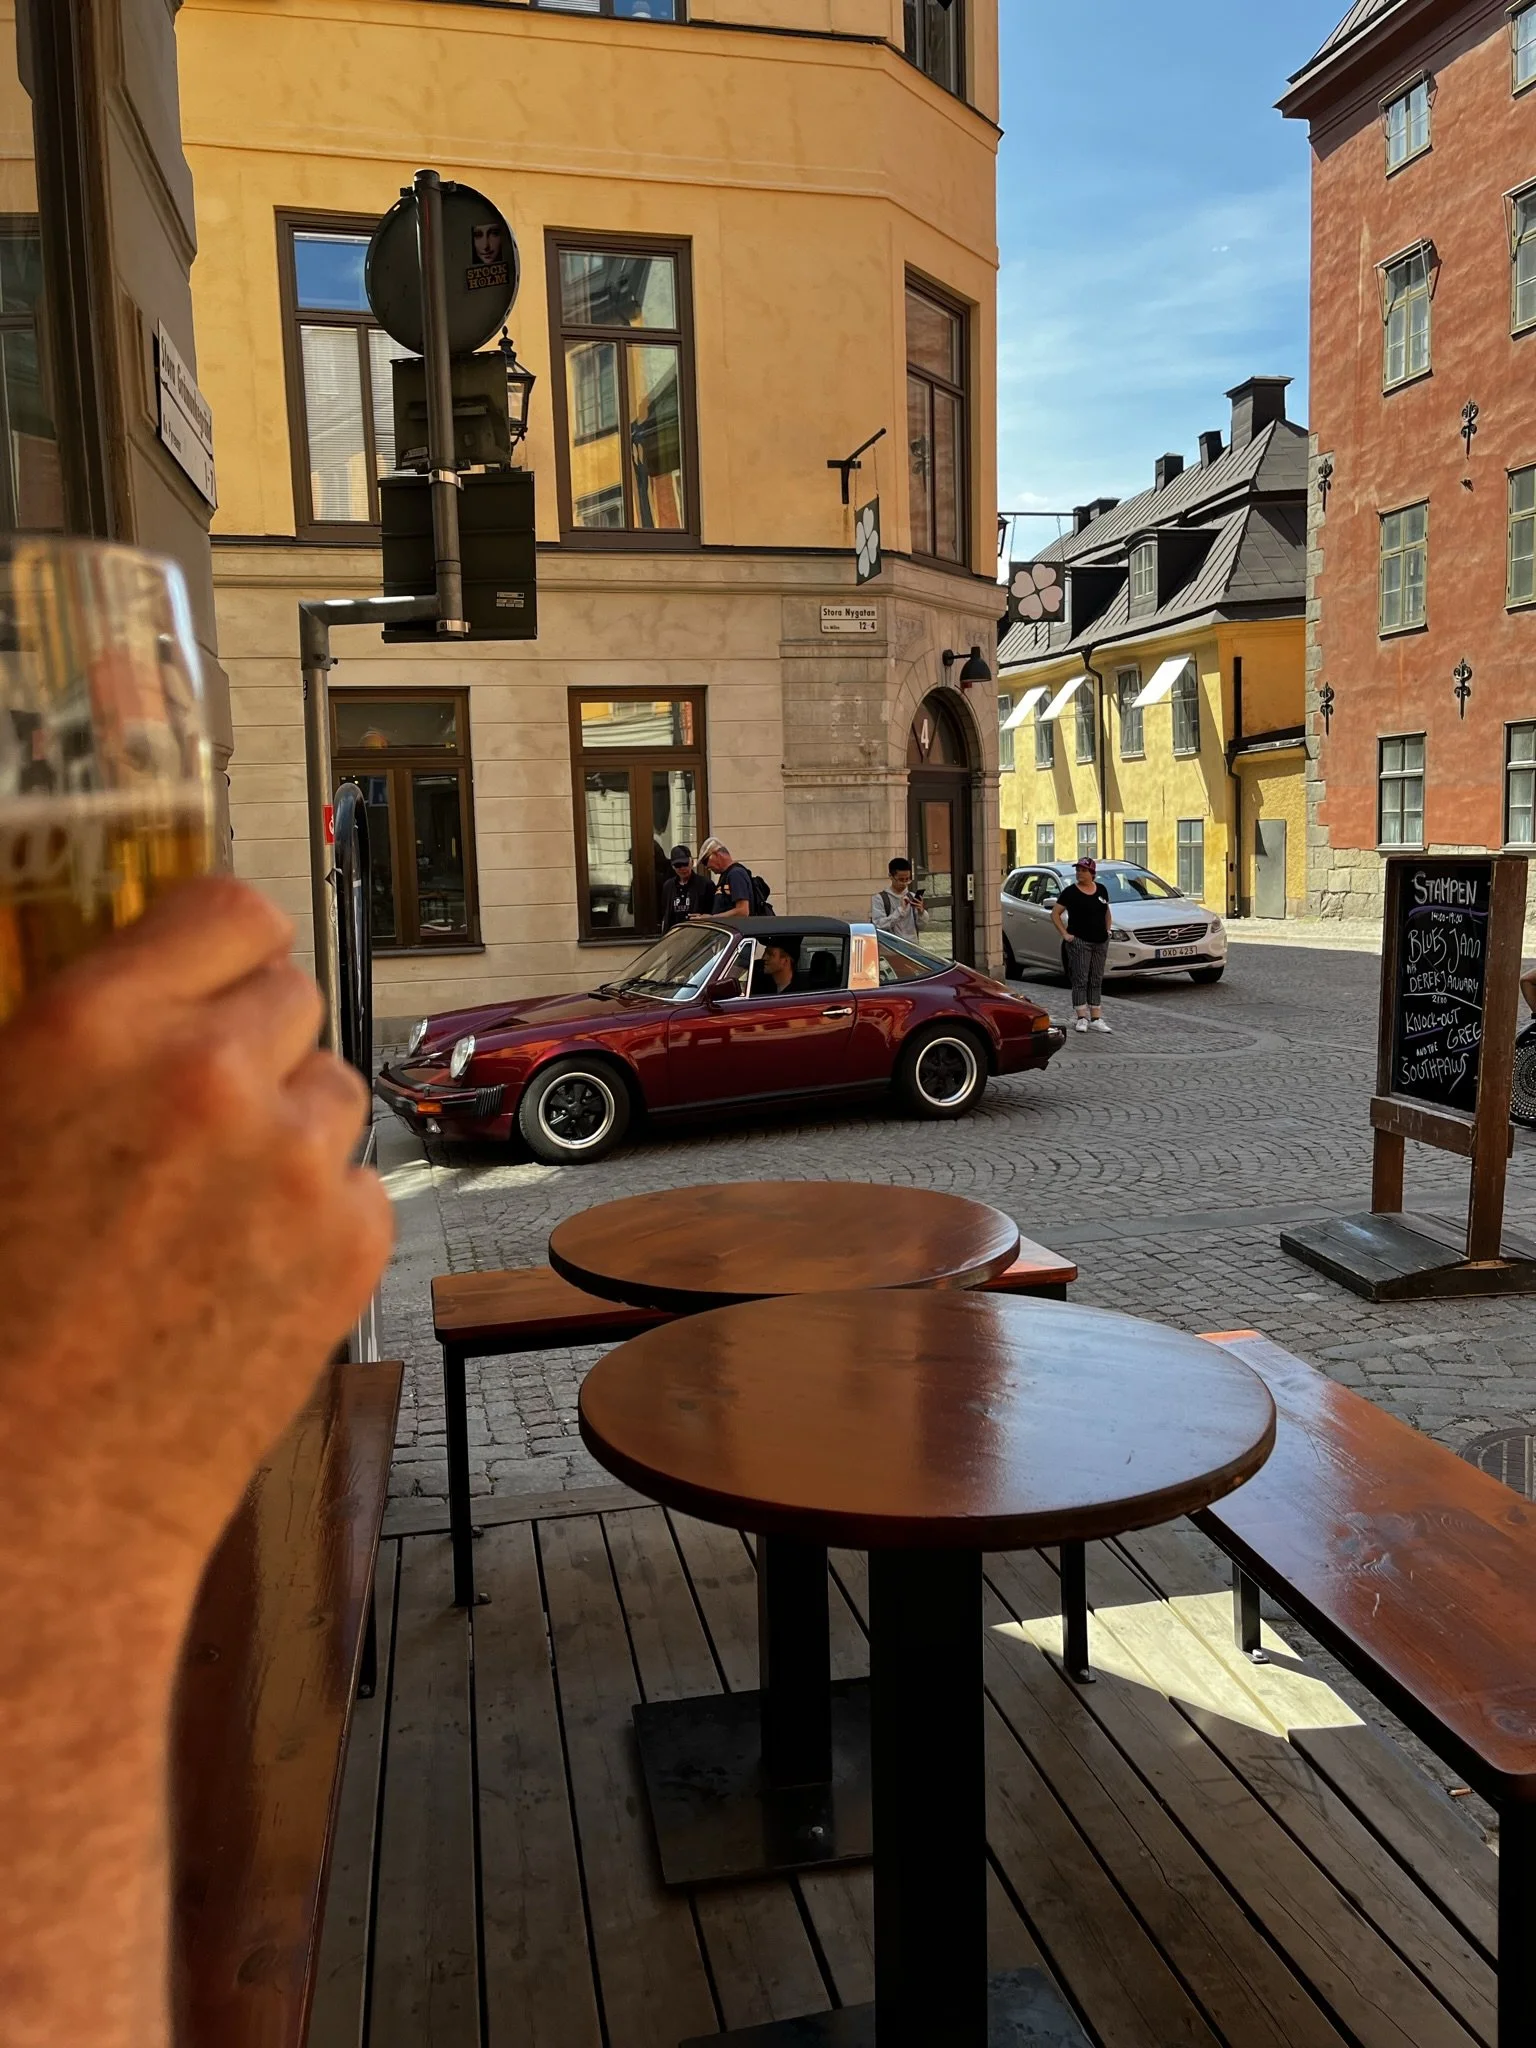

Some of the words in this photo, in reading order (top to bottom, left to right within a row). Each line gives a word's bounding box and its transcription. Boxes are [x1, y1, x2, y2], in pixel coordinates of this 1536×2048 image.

[467, 264, 507, 279] STOCK
[469, 274, 508, 289] HOLM
[823, 608, 842, 617] Stora
[845, 608, 876, 618] Nygatan
[921, 718, 930, 749] 4
[1413, 871, 1478, 905] STAMPEN
[1408, 927, 1447, 966] BLUES
[1409, 971, 1440, 992] DEREK
[1436, 970, 1479, 1003] JANUARY
[1405, 1007, 1461, 1033] KNOCK-OUT
[1447, 1022, 1482, 1049] GREG
[1401, 1053, 1469, 1094] SOUTHPAWS
